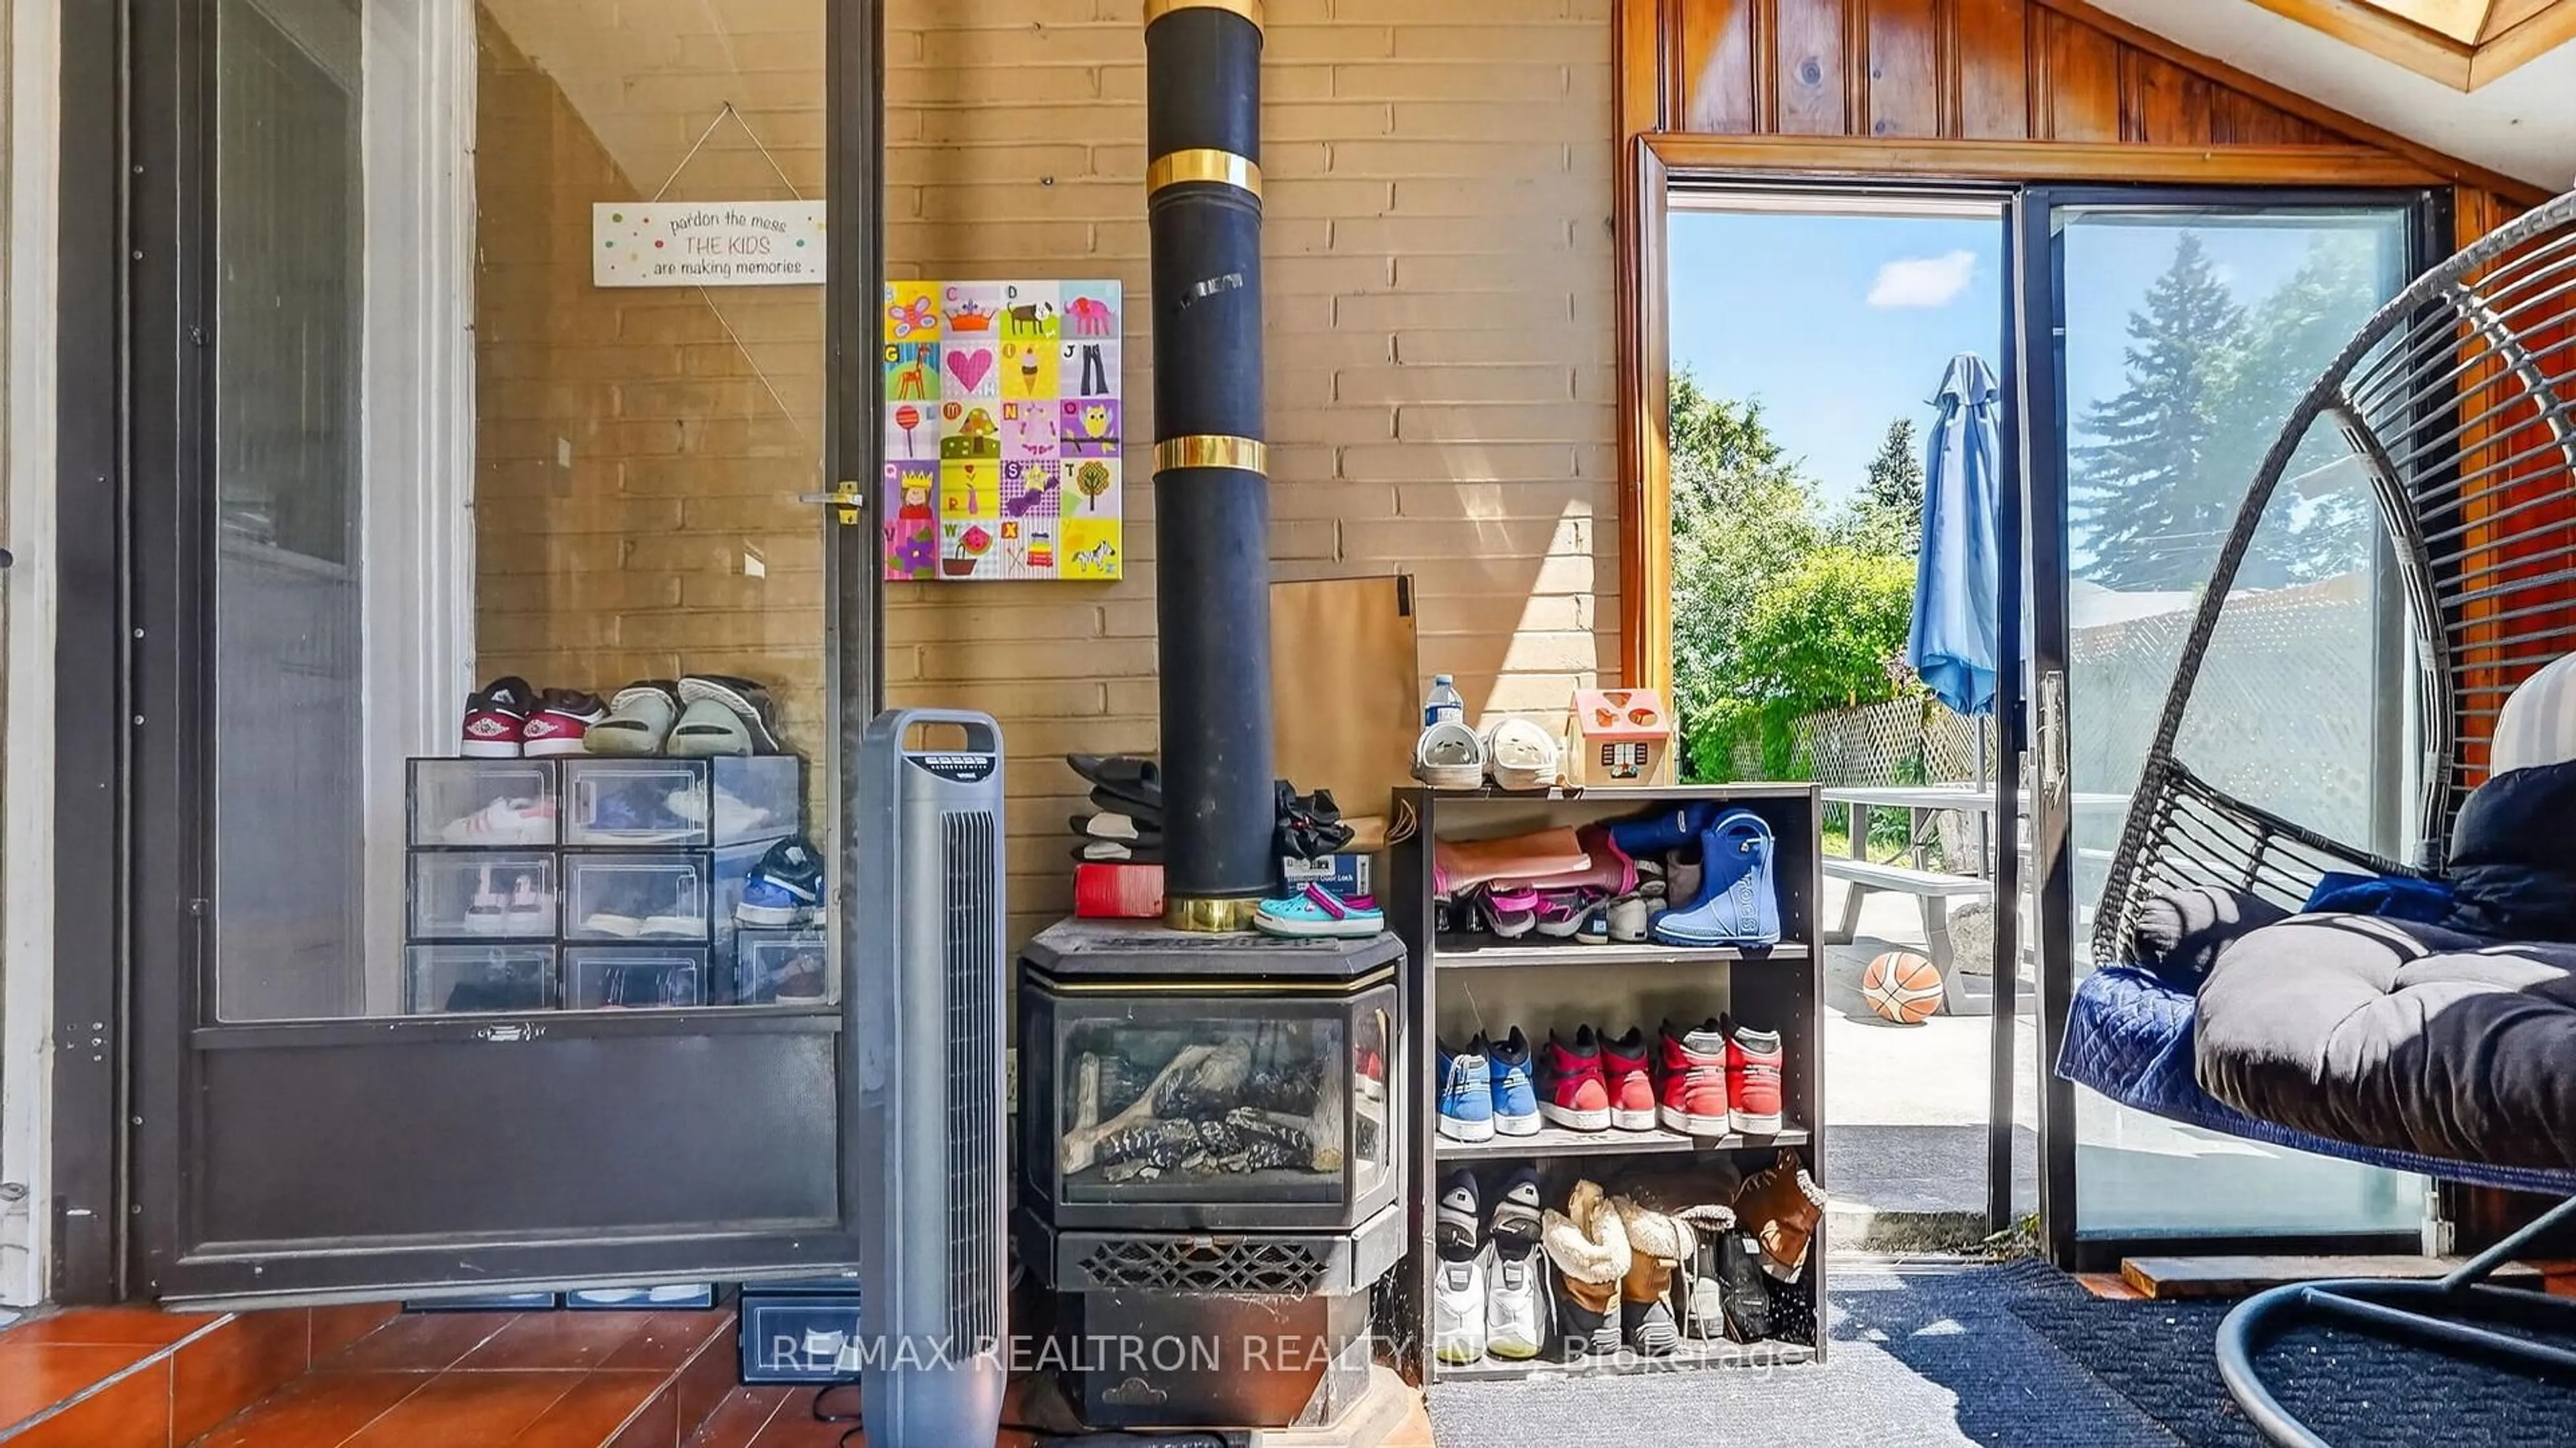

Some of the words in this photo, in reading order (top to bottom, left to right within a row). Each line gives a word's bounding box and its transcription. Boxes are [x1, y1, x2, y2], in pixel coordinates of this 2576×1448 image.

[670, 210, 719, 236] pardon
[724, 209, 746, 226] the
[751, 215, 786, 233] mess
[687, 237, 722, 254] THE
[729, 236, 771, 254] KIDS
[653, 262, 676, 274] are
[681, 258, 731, 278] making
[737, 258, 802, 274] memories
[946, 287, 957, 301] C
[1008, 285, 1018, 299] D
[885, 346, 898, 362] G
[1064, 344, 1075, 358] J
[884, 464, 897, 479] Q
[1008, 464, 1018, 478] S
[1065, 464, 1075, 476] T
[949, 497, 959, 511] R
[883, 527, 896, 541] V
[945, 524, 957, 537] W
[1006, 523, 1017, 537] X
